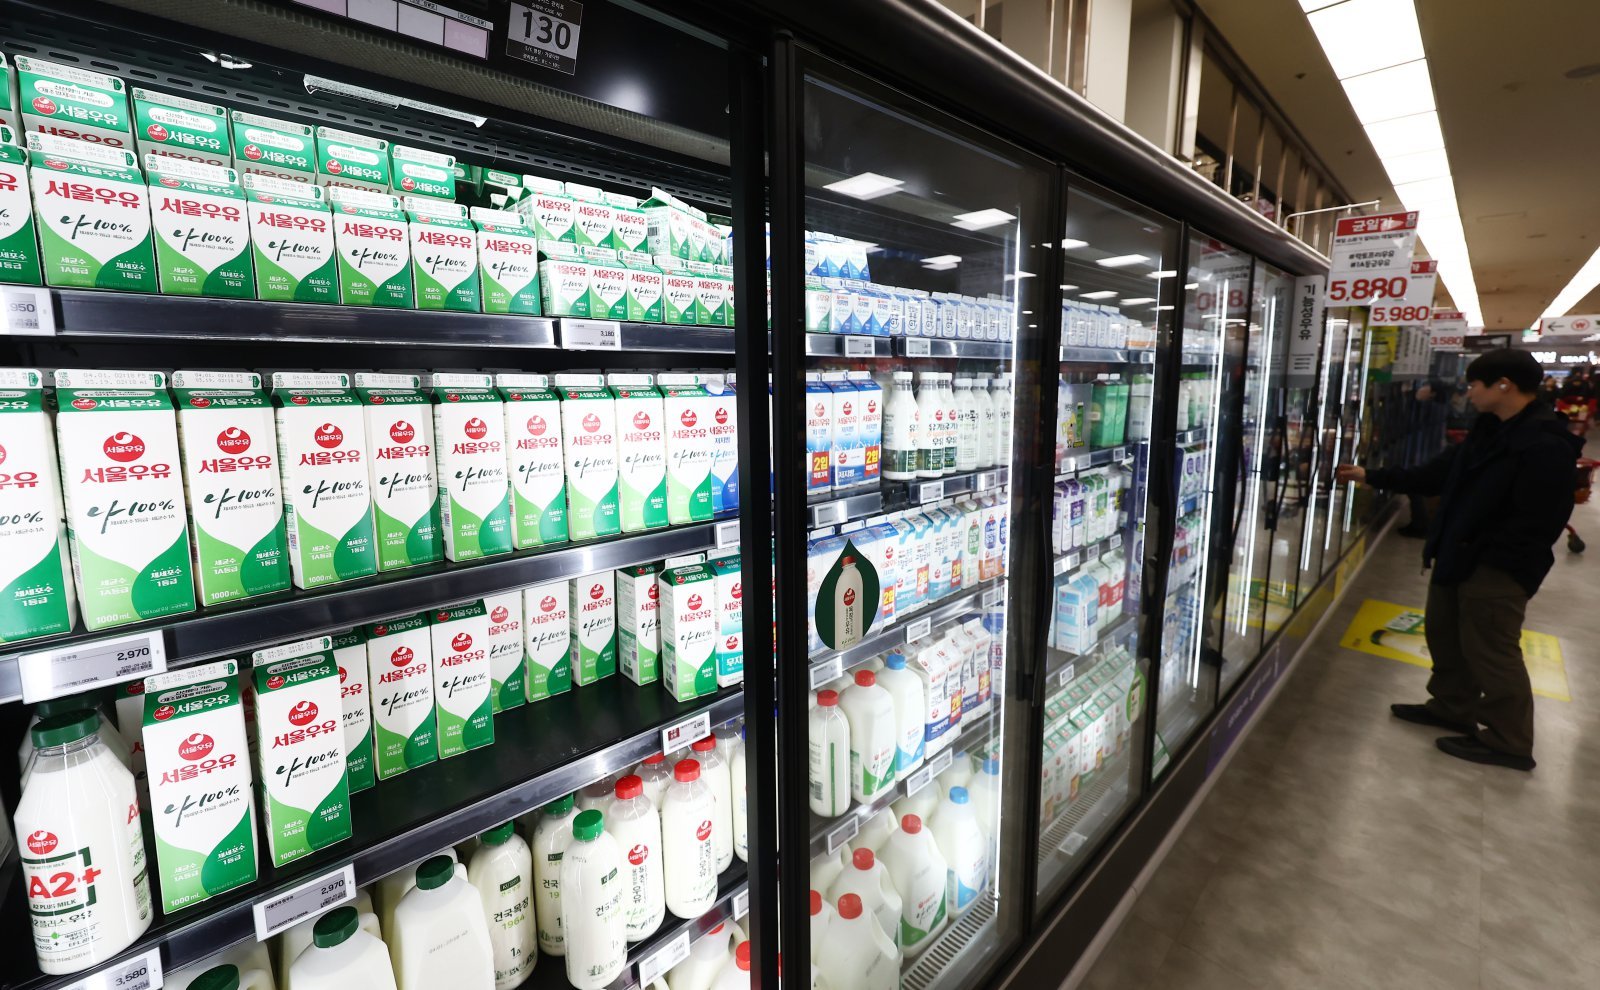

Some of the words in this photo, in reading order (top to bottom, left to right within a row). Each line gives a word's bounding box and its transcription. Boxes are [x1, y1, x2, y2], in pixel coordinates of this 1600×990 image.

[523, 11, 571, 50] 130
[57, 104, 119, 126] 서울우유
[45, 181, 140, 209] 서울우유
[160, 198, 240, 222] 서울우유
[537, 199, 571, 212] 서울우유
[578, 205, 610, 218] 서울우유
[258, 212, 327, 233] 서울우유
[616, 213, 645, 226] 서울우유
[1352, 217, 1393, 232] 균일가
[60, 215, 132, 240] 나100%
[342, 222, 404, 242] 서울우유
[173, 228, 234, 251] 나100%
[418, 231, 472, 249] 서울우유
[485, 239, 533, 255] 서울우유
[268, 240, 321, 261] 나100%
[352, 248, 398, 268] 나100%
[61, 257, 86, 265] 세균수
[60, 266, 89, 275] 1A등급
[122, 272, 141, 280] 1등급
[593, 270, 625, 281] 서울우유
[631, 274, 660, 285] 서울우유
[667, 278, 694, 288] 서울우유
[1330, 277, 1407, 302] 5,880
[1299, 284, 1316, 340] 기능성우유
[1372, 306, 1429, 322] 5,980
[100, 400, 162, 408] 서울우유
[572, 435, 612, 447] 서울우유
[624, 432, 661, 443] 서울우유
[672, 429, 707, 439] 서울우유
[452, 441, 501, 455] 서울우유
[516, 438, 558, 450] 서울우유
[299, 450, 361, 466] 서울우유
[376, 445, 430, 460] 서울우유
[866, 450, 879, 464] 2입
[199, 456, 272, 473] 서울우유
[814, 456, 828, 472] 2입
[81, 463, 171, 483] 서울우유
[455, 467, 503, 492] 나100%
[380, 472, 432, 499] 나100%
[150, 566, 182, 578] 체세포수
[214, 567, 238, 575] 1A등급
[684, 573, 708, 582] 서울우유
[157, 579, 178, 587] 1등급
[14, 584, 54, 598] 체세포수
[211, 590, 230, 599] 1000
[22, 598, 48, 607] 1등급
[582, 598, 612, 612] 서울우유
[96, 614, 118, 624] 1000
[531, 610, 566, 626] 서울우유
[679, 609, 712, 624] 서울우유
[117, 648, 150, 661] 2,970
[440, 650, 485, 668] 서울우유
[286, 666, 331, 684] 서울우유
[378, 664, 427, 685] 서울우유
[442, 673, 486, 699] 나100%
[175, 695, 230, 714] 서울우유
[381, 688, 428, 716] 나100%
[272, 720, 337, 749] 서울우유
[160, 754, 237, 786] 서울우유
[324, 812, 340, 822] 1등급
[218, 843, 245, 860] 체세포수
[280, 849, 296, 860] 1000
[223, 855, 242, 865] 1등급
[29, 868, 102, 899] A2+
[321, 880, 345, 895] 2,970
[543, 880, 559, 889] 건국
[57, 899, 76, 908] MILK
[171, 896, 189, 907] 1000
[494, 897, 529, 923] 건국목장
[502, 915, 525, 930] 1964
[116, 967, 147, 986] 3,580
